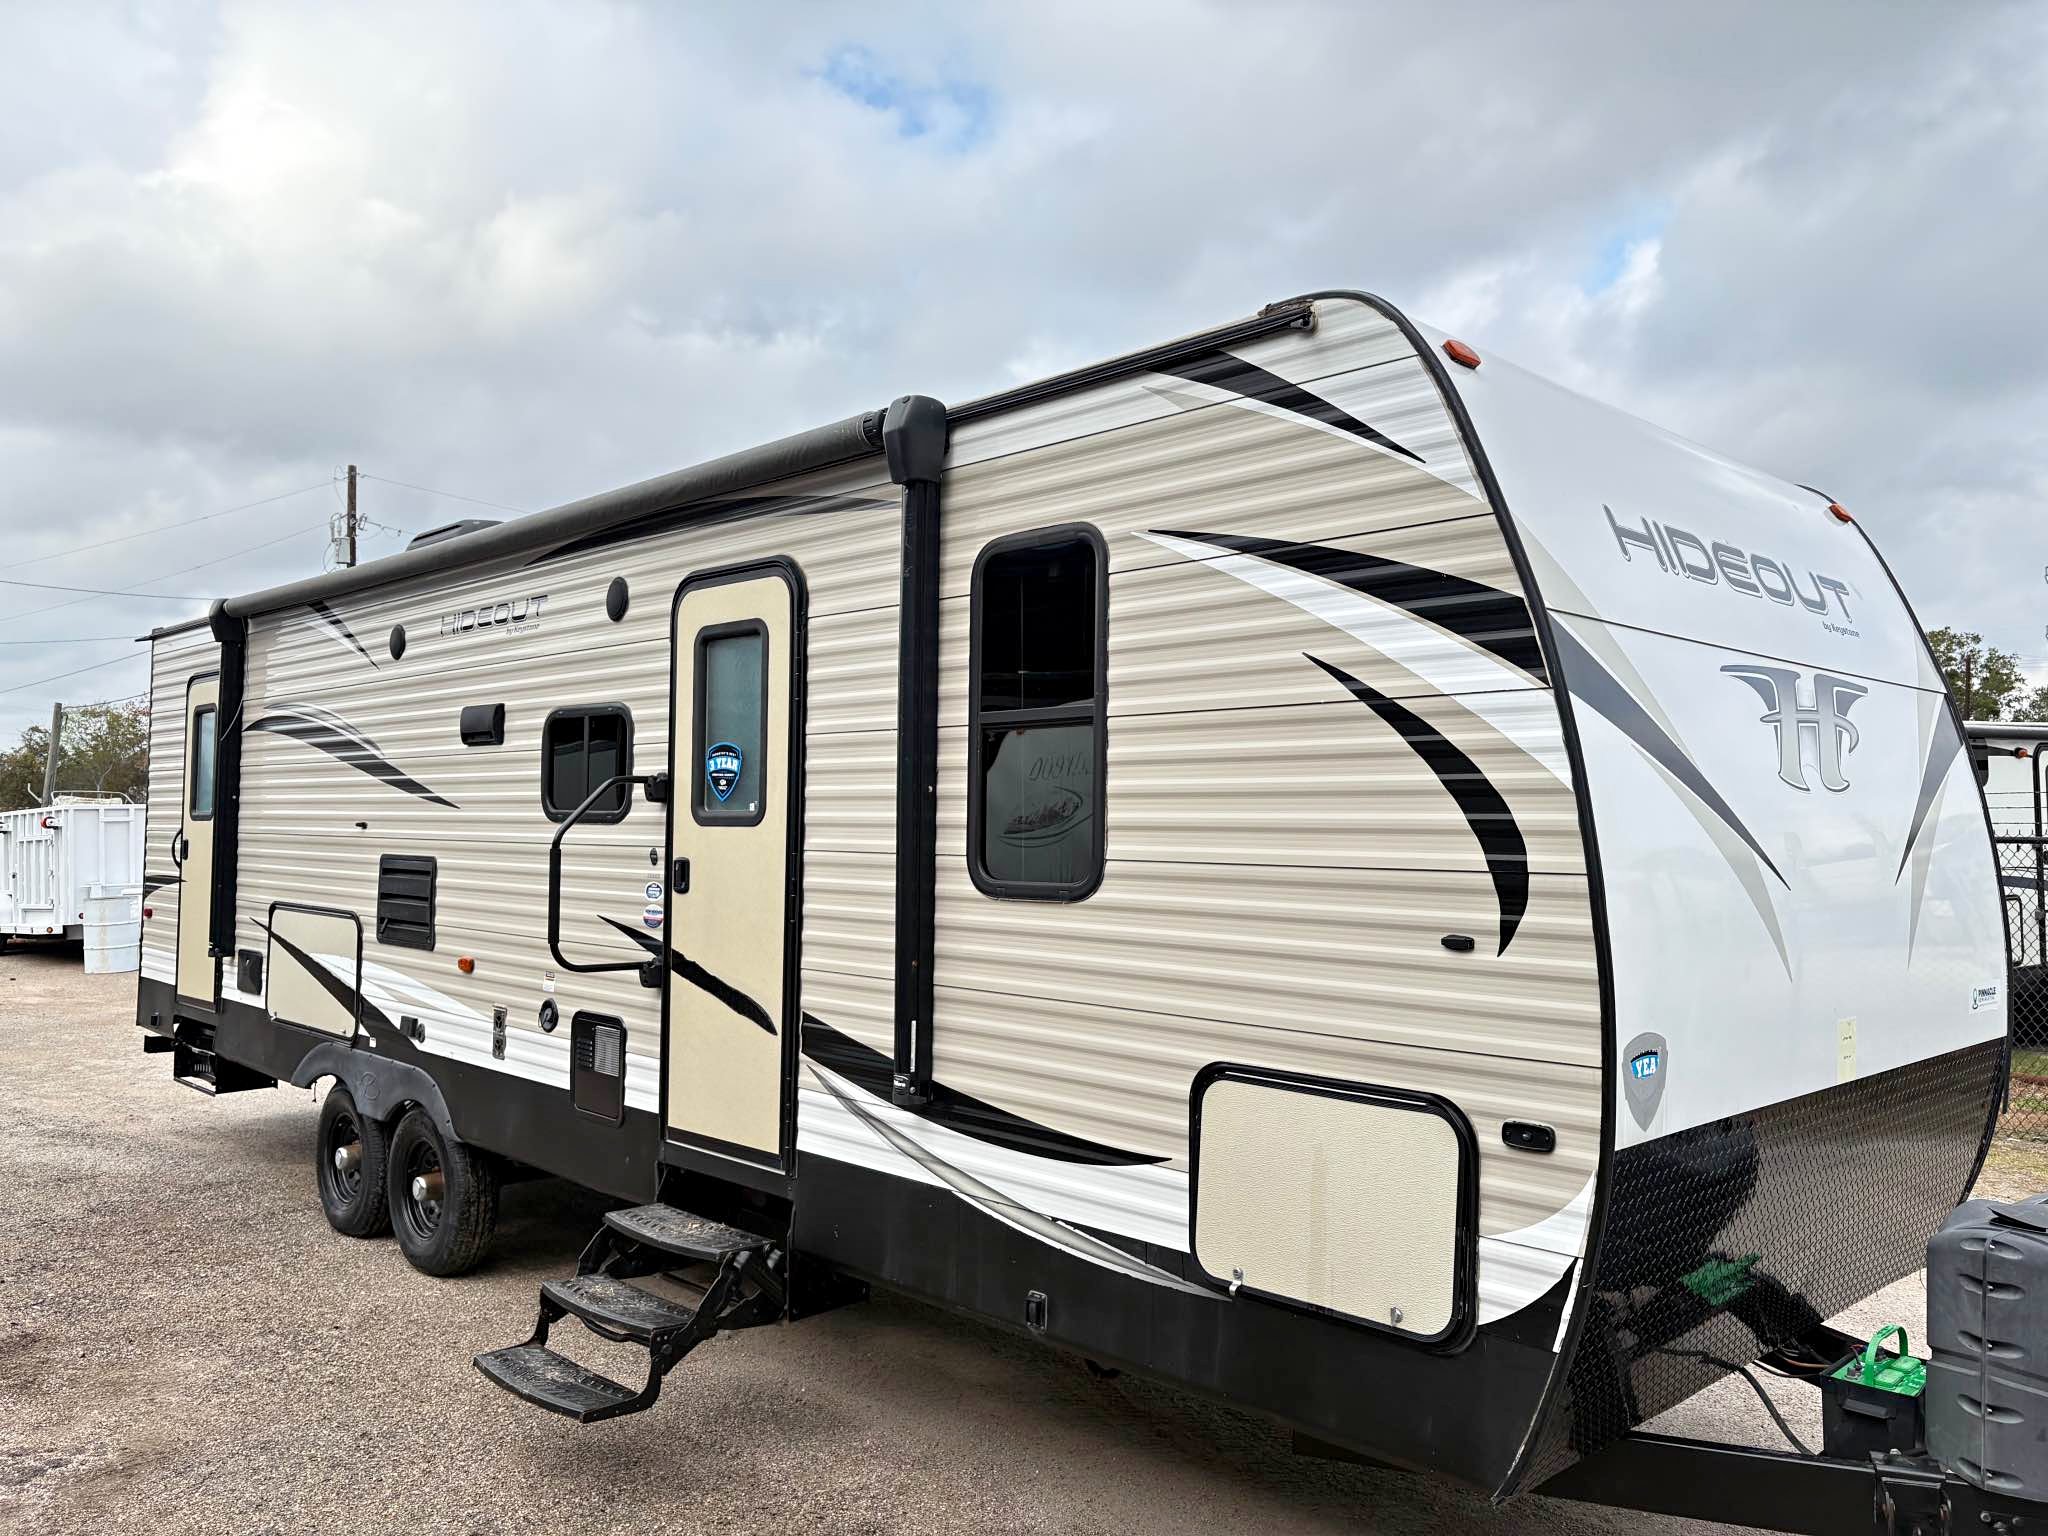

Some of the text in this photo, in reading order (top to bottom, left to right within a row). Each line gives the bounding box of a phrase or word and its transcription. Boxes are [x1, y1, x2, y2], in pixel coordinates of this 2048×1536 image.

[1604, 504, 1852, 624] HIDEOUT
[440, 595, 548, 637] HIDEOUT
[716, 757, 739, 770] YEAR
[1635, 1056, 1660, 1078] YEA
